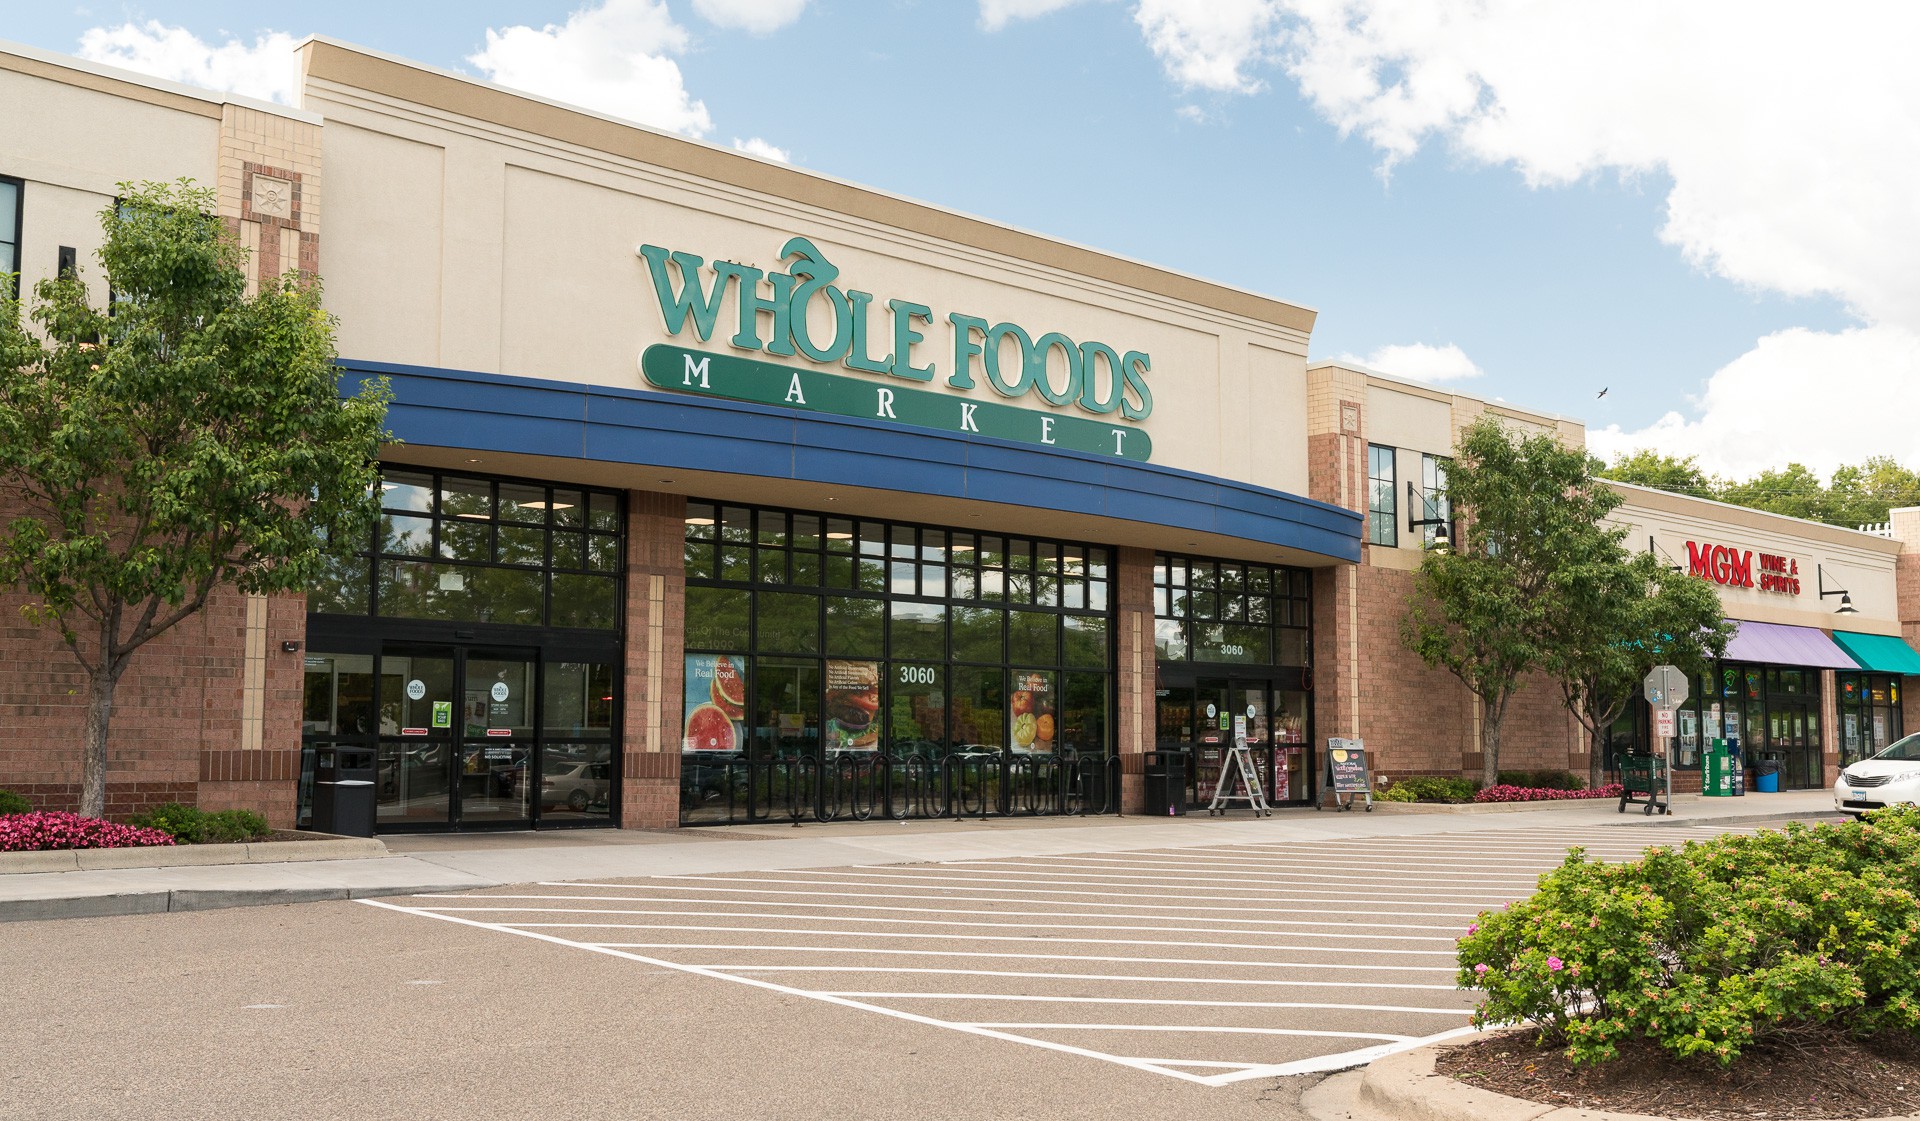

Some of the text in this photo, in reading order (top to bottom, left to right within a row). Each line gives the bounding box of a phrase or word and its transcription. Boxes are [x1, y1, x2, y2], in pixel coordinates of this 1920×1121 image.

[637, 237, 1153, 421] WHOLE FOODS
[682, 353, 1127, 456] MARKET
[1685, 540, 1755, 588] MGM
[1758, 553, 1798, 575] WINE &
[1760, 573, 1800, 595] SPIRITS
[1220, 644, 1243, 656] 3060
[695, 659, 705, 667] We
[706, 660, 728, 668] Believe
[695, 668, 735, 679] Real Food
[900, 665, 935, 684] 3060
[1018, 683, 1048, 692] Real Food
